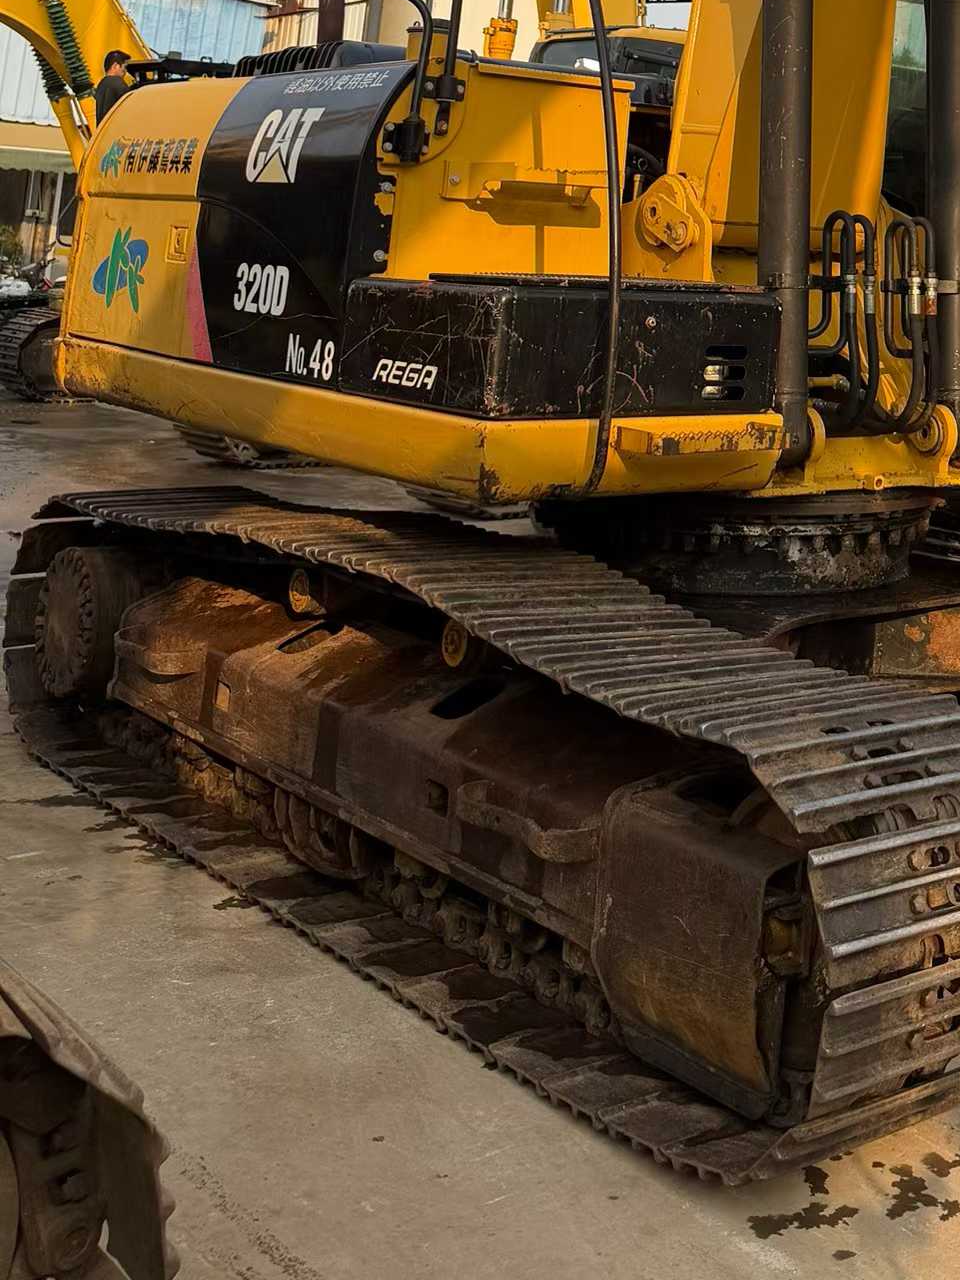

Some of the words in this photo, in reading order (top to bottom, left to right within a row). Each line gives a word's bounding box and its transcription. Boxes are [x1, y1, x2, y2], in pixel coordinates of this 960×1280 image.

[246, 108, 325, 183] CAT
[233, 262, 289, 316] 320D
[285, 333, 335, 381] No.48
[372, 358, 438, 390] REGA
